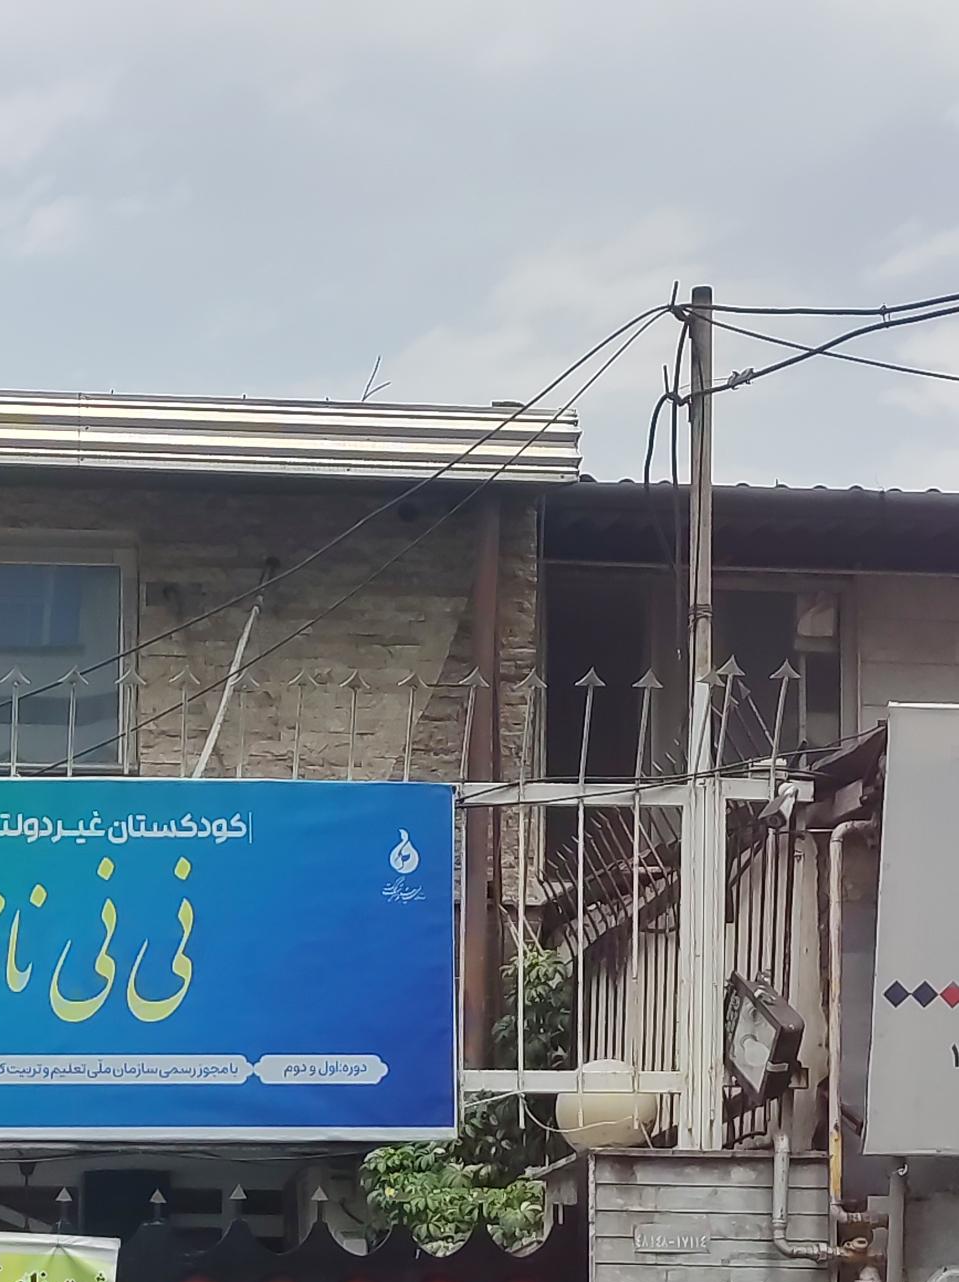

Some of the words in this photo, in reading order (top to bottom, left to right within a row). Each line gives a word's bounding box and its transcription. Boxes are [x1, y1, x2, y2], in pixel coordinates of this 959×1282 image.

[108, 812, 247, 844] کودکستان
[49, 856, 118, 1023] نی
[126, 856, 194, 1023] نی
[6, 1062, 42, 1079] تربیت
[42, 1067, 50, 1079] و
[50, 1061, 88, 1080] تعلیم
[112, 1062, 158, 1078] سازمان
[158, 1067, 198, 1079] رسمی
[197, 1062, 229, 1078] مجوز
[229, 1061, 239, 1077] با
[283, 1064, 308, 1078] دوم
[309, 1066, 317, 1078] و
[318, 1060, 339, 1077] اول
